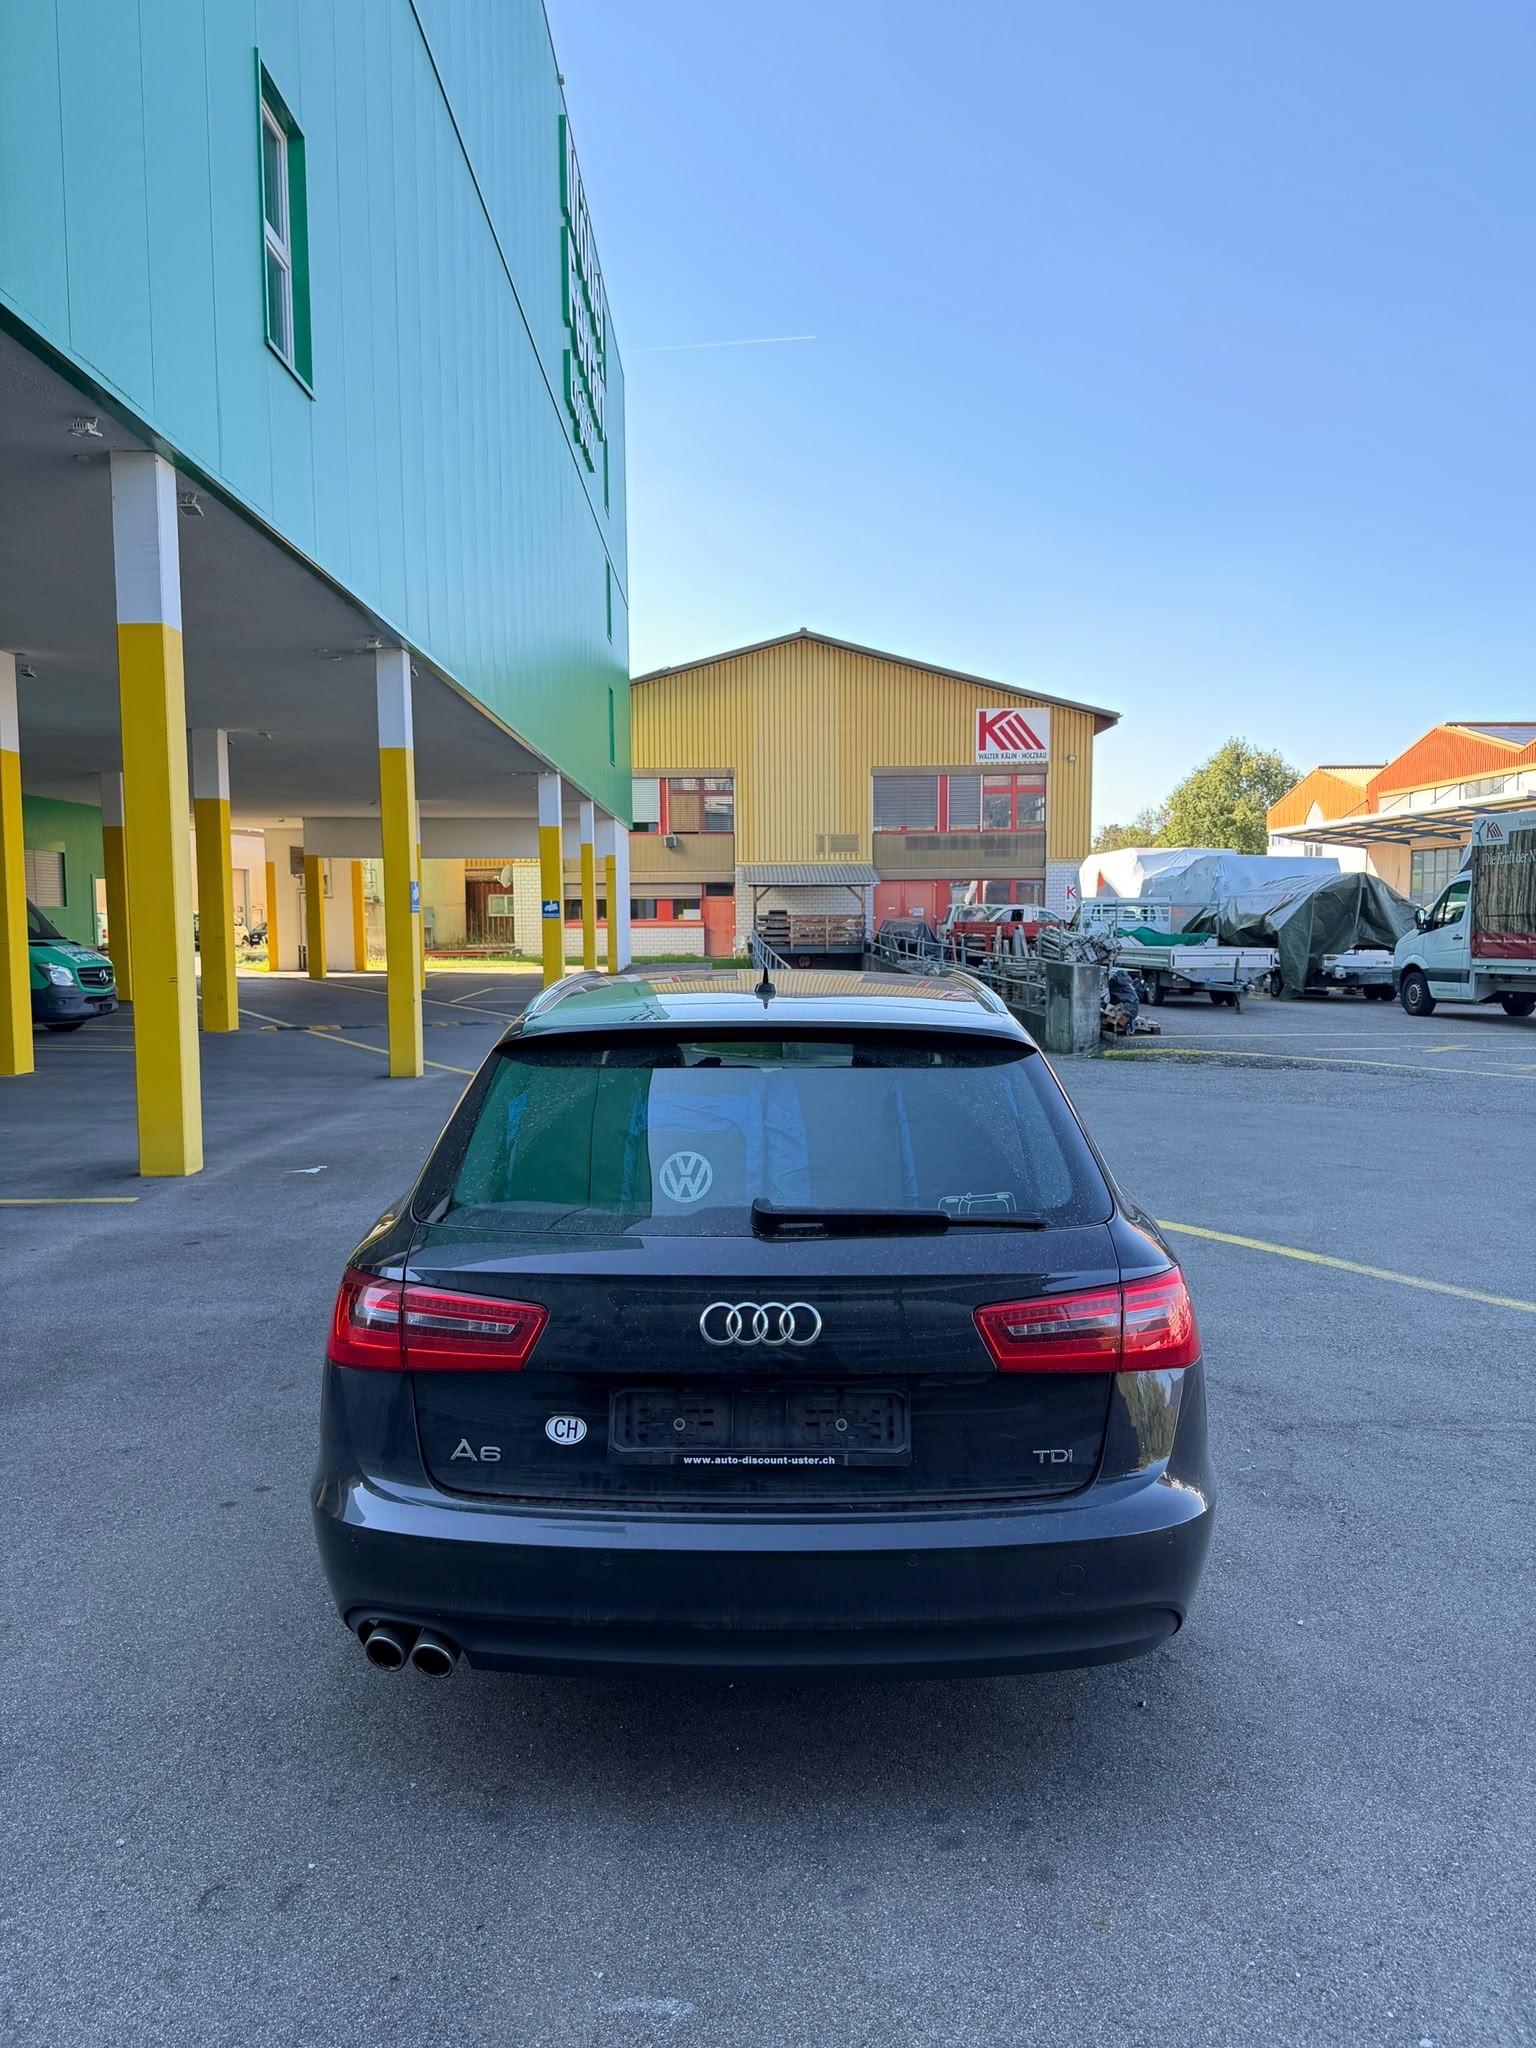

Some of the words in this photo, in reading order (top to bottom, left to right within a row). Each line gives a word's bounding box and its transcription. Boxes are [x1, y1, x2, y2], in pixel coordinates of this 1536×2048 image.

[978, 752, 999, 760] WALTER
[1001, 752, 1017, 760] KÄLIN
[554, 1419, 579, 1439] CH
[450, 1438, 501, 1462] A6
[1033, 1448, 1073, 1464] TDI
[683, 1455, 836, 1465] www.auto-discount-uster.ch
